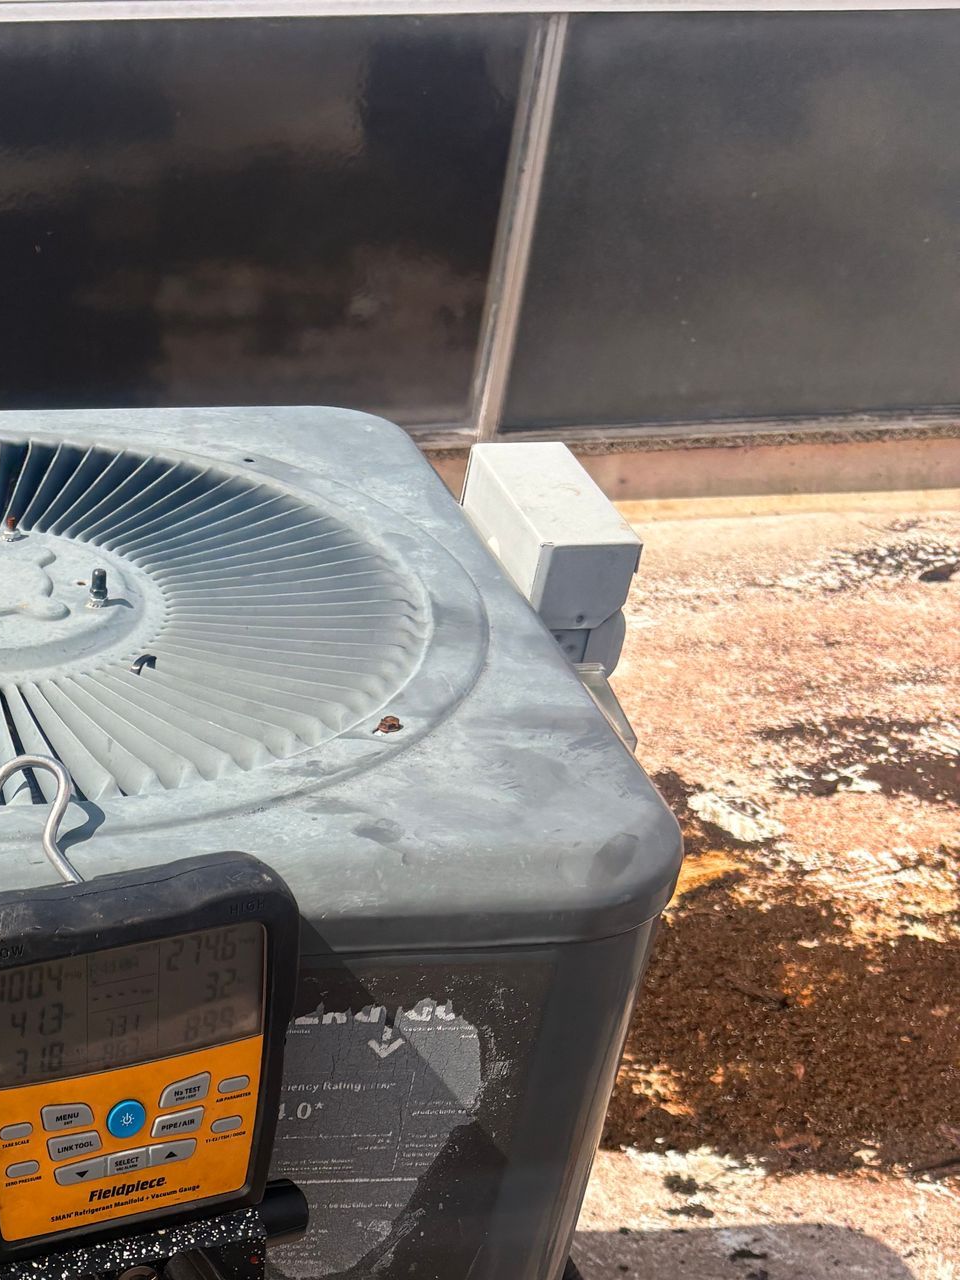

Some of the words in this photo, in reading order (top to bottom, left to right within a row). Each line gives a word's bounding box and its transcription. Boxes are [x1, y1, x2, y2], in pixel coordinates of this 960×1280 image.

[230, 899, 265, 916] HIGH
[184, 1085, 201, 1095] TEST
[224, 1091, 252, 1102] PARAMETER
[55, 1111, 80, 1123] MENU
[2, 1142, 14, 1150] TARE
[14, 1139, 30, 1147] SCALE
[57, 1144, 74, 1154] LINK
[74, 1140, 94, 1150] TOOL
[114, 1156, 140, 1168] SELECT
[18, 1175, 42, 1185] PRESSURE
[88, 1176, 166, 1203] Fieldpiece
[74, 1203, 113, 1217] Refrigerant
[114, 1195, 144, 1209] Manifold
[150, 1188, 178, 1200] Vacuum
[178, 1184, 201, 1195] Gauge
